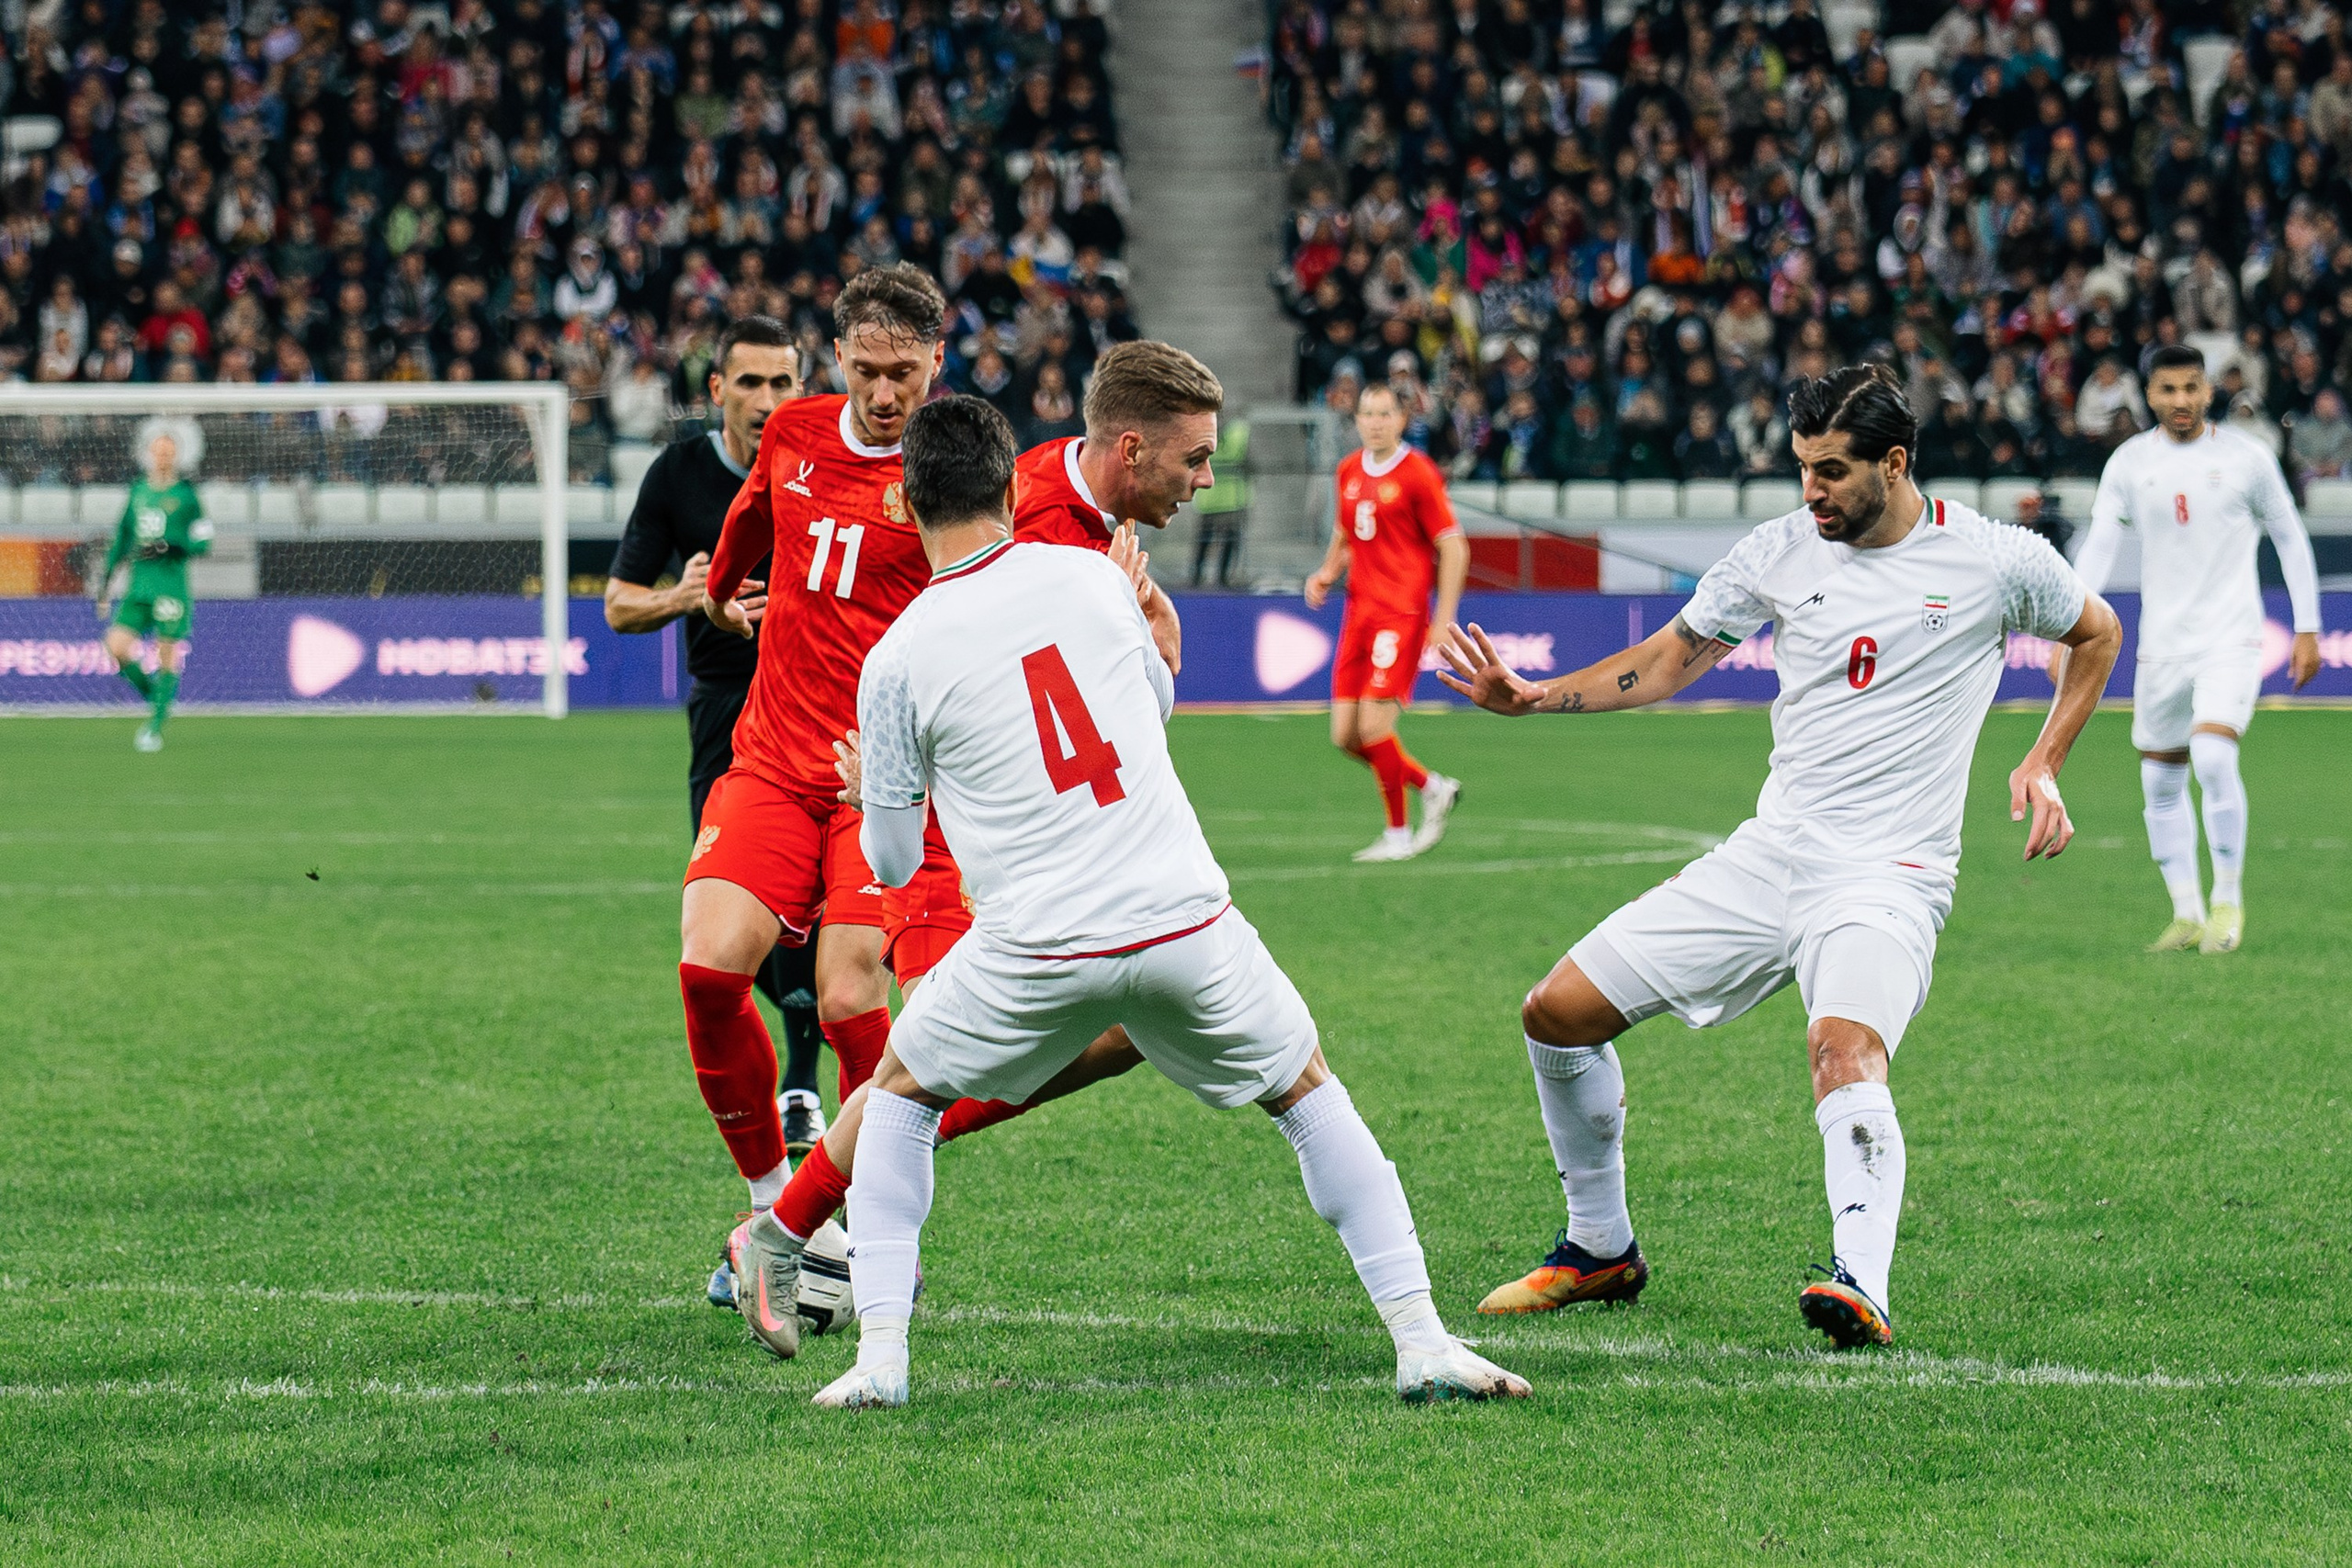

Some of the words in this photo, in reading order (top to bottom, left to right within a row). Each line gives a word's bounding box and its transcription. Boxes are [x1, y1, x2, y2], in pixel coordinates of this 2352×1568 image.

[1354, 500, 1377, 541] 5
[807, 516, 865, 600] 11
[1371, 629, 1400, 670] 5
[1848, 636, 1878, 689] 6
[1022, 643, 1126, 807] 4
